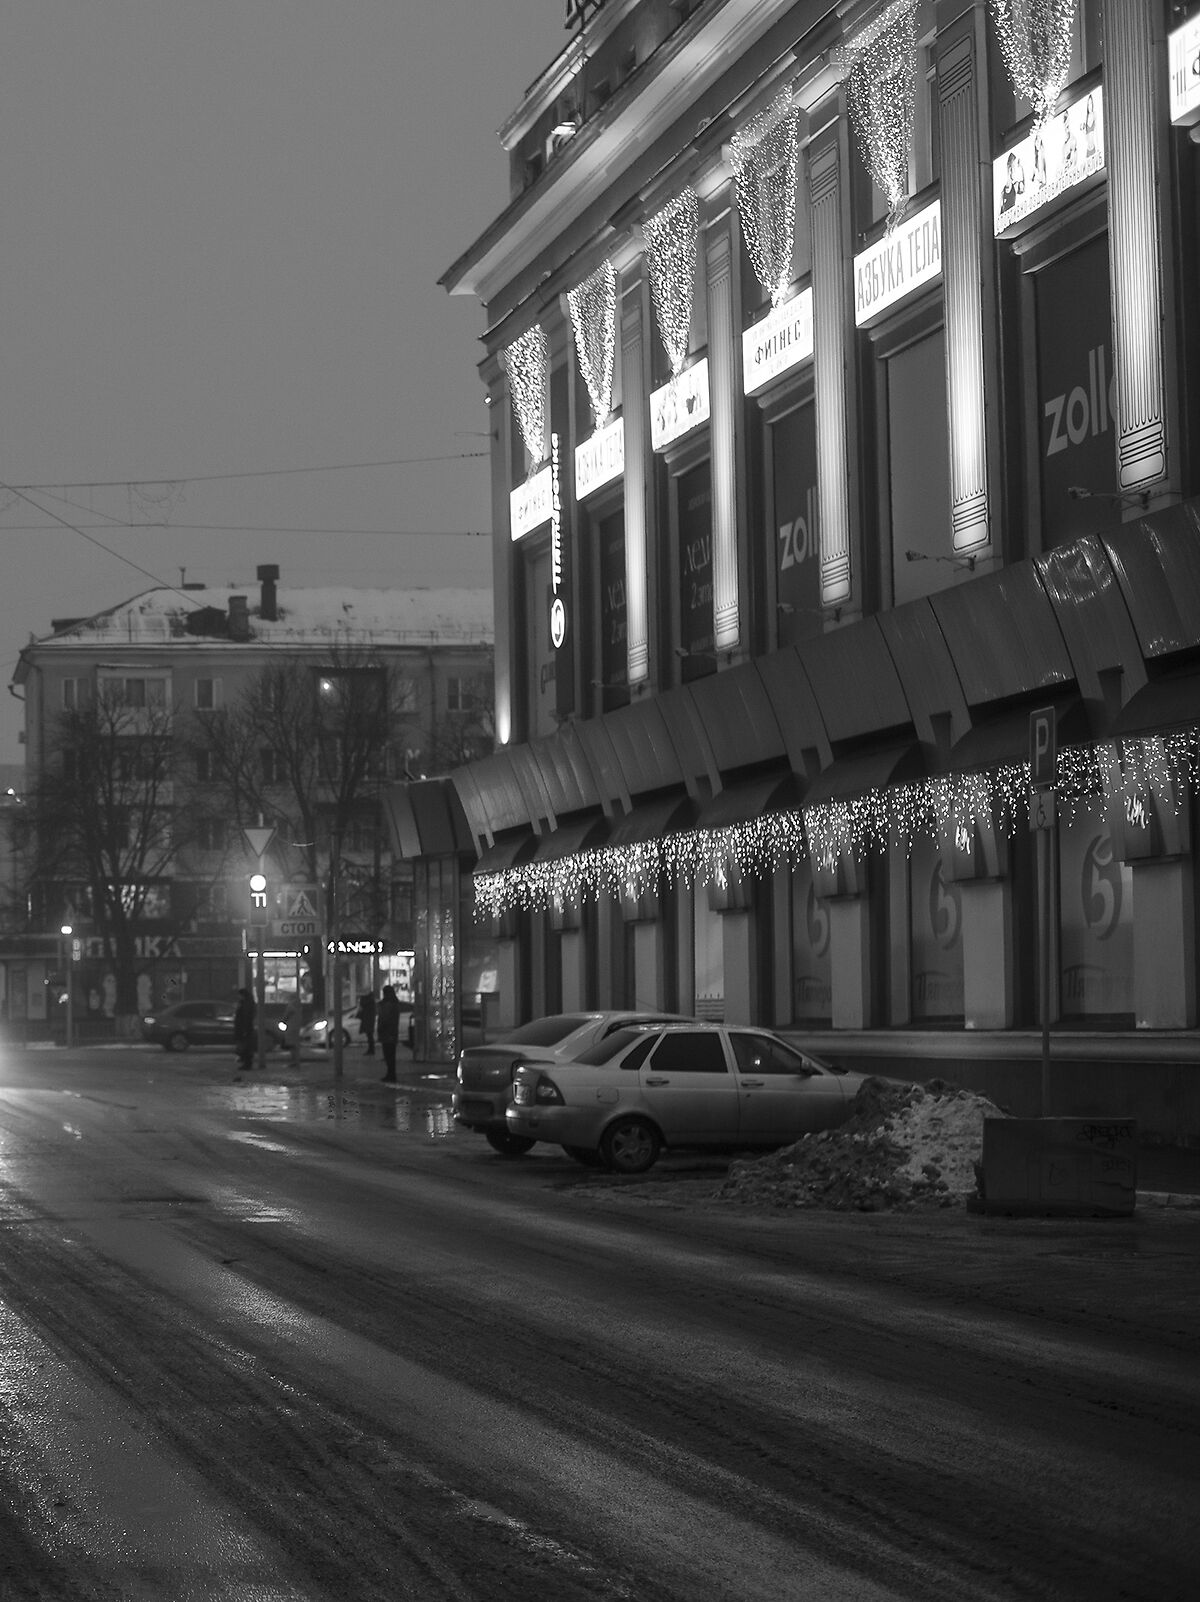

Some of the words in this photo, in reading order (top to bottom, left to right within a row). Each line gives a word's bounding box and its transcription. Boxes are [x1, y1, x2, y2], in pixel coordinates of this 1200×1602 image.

[857, 238, 905, 313] АЗБУКА
[907, 216, 940, 288] ТЕЛА
[753, 317, 802, 366] ФИТНЕС
[1044, 343, 1118, 457] zoll
[779, 486, 818, 572] zoll
[1035, 718, 1049, 777] P
[281, 922, 316, 935] СТОП
